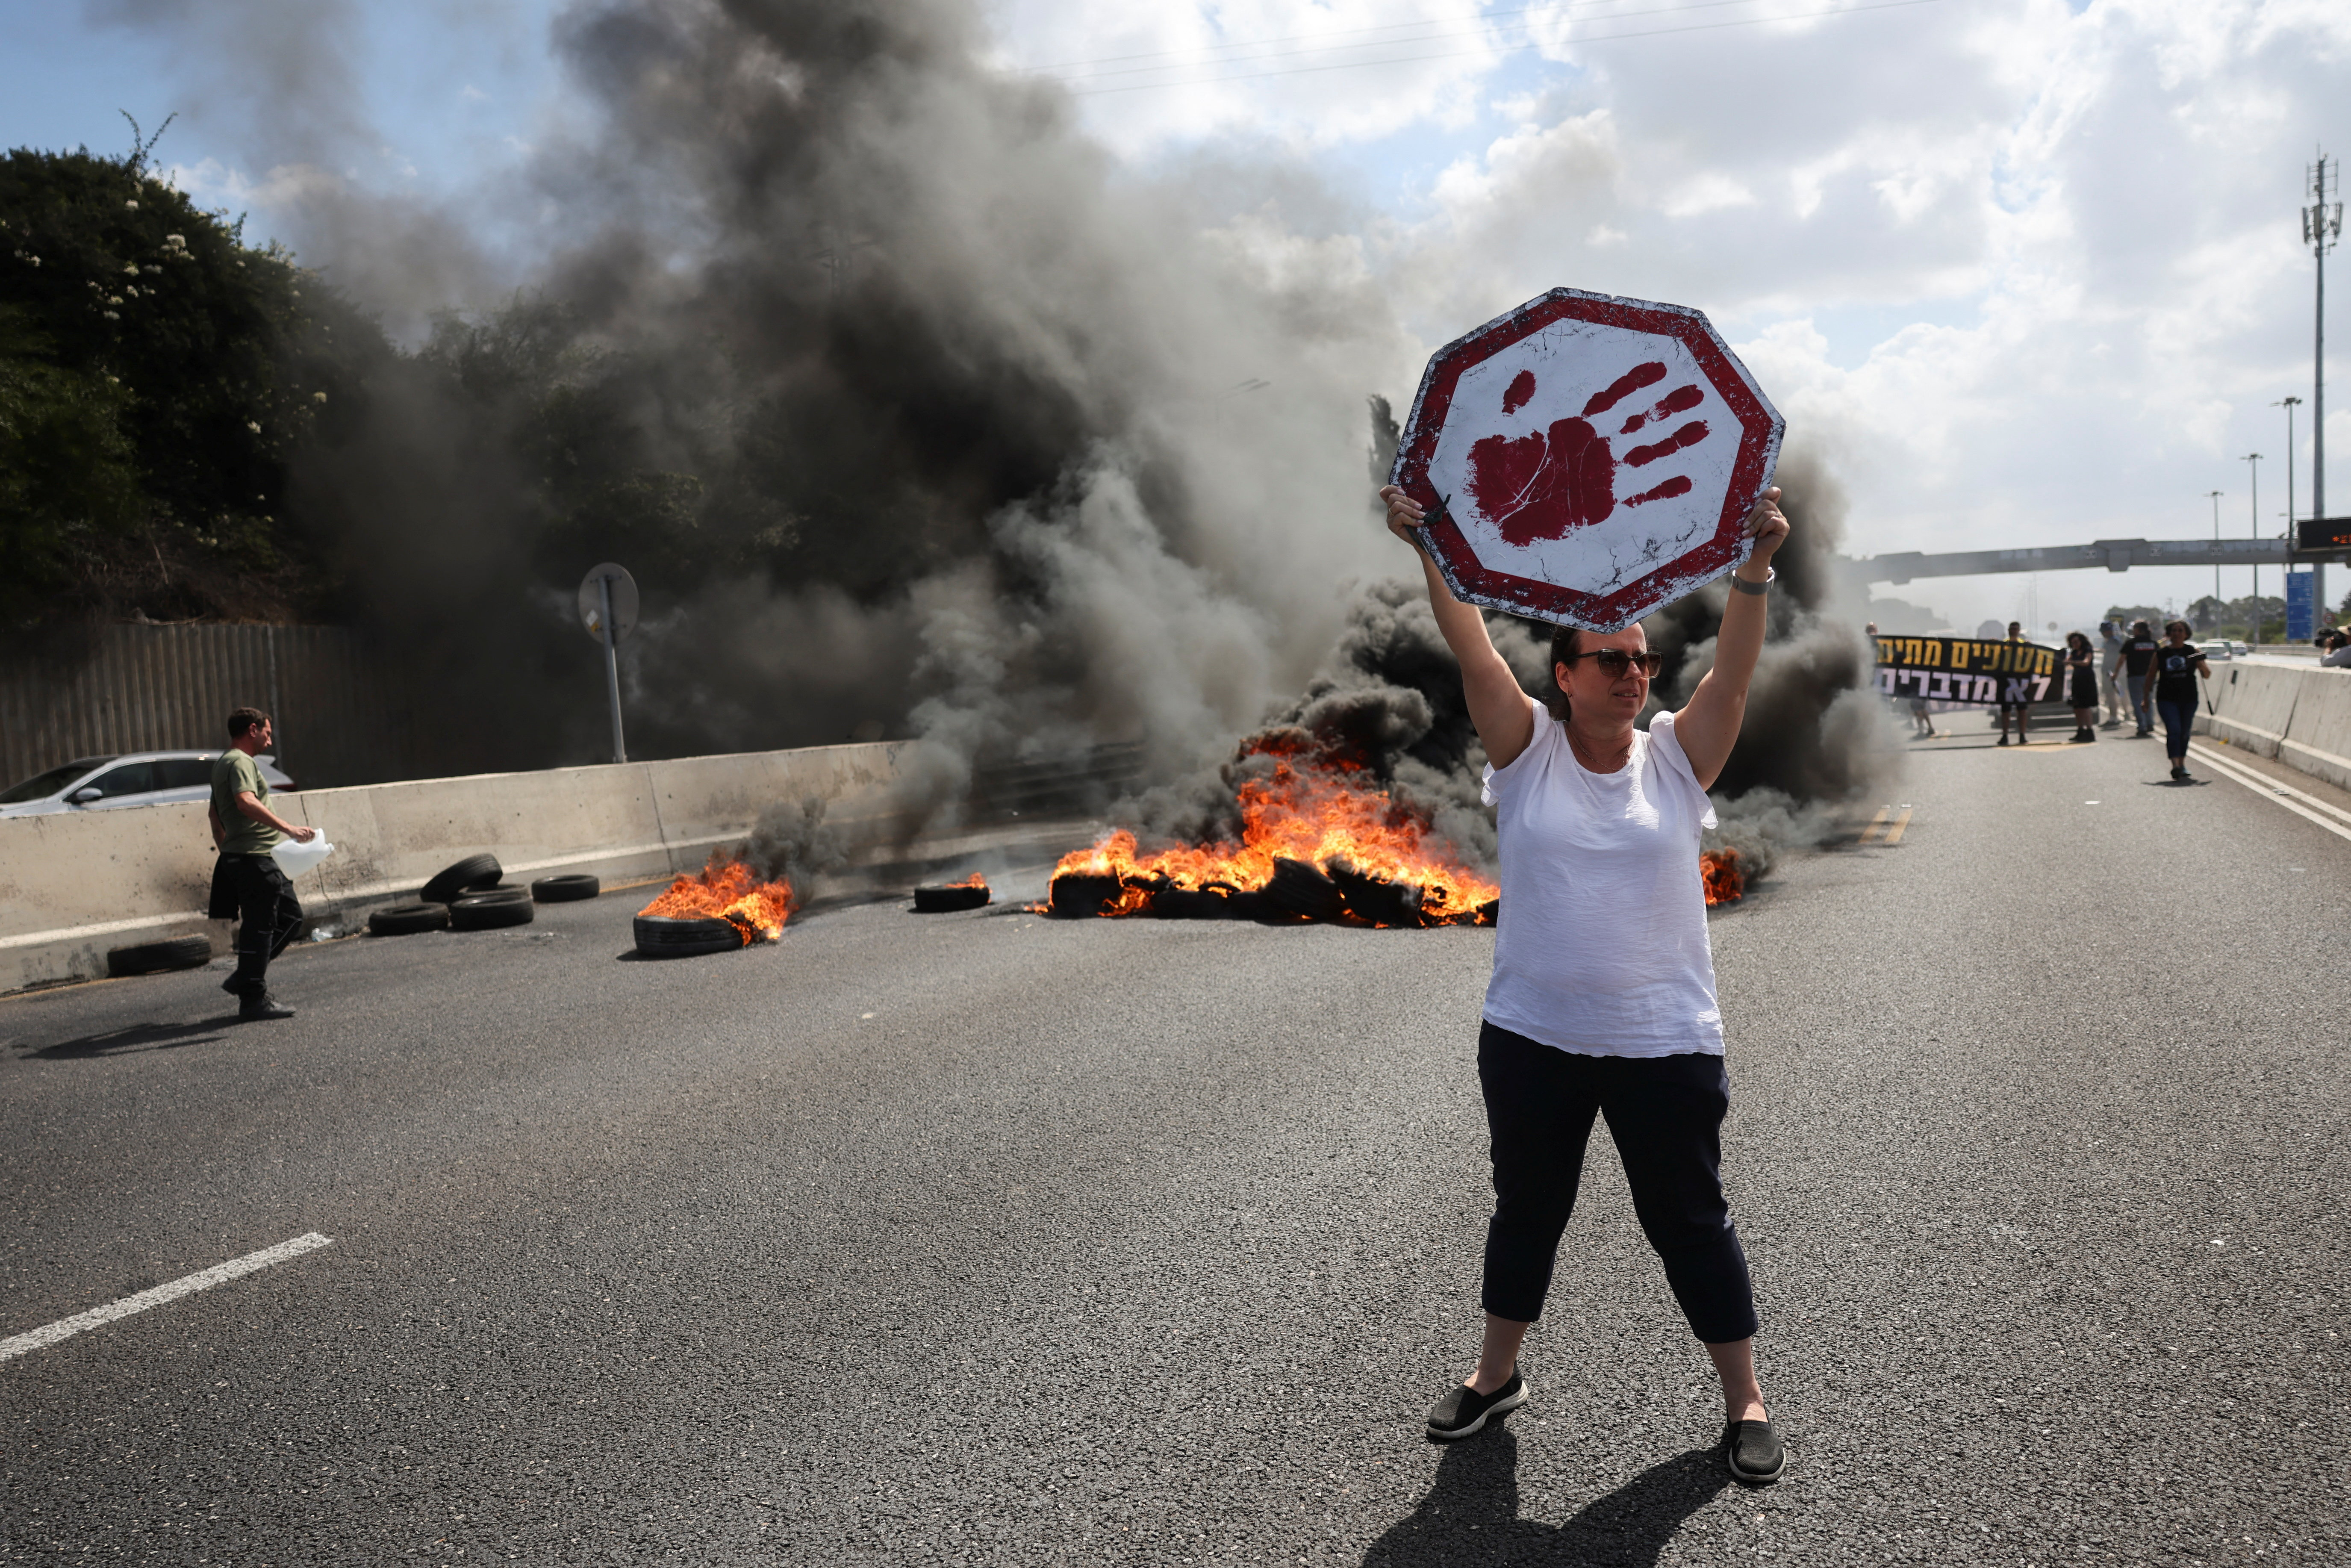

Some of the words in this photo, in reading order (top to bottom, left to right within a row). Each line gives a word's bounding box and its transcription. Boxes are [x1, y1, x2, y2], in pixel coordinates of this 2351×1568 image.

[1877, 638, 1942, 666] מתים
[1951, 641, 2055, 675] חטופים
[1876, 668, 1998, 702] מדברים
[2005, 673, 2051, 702] לא
